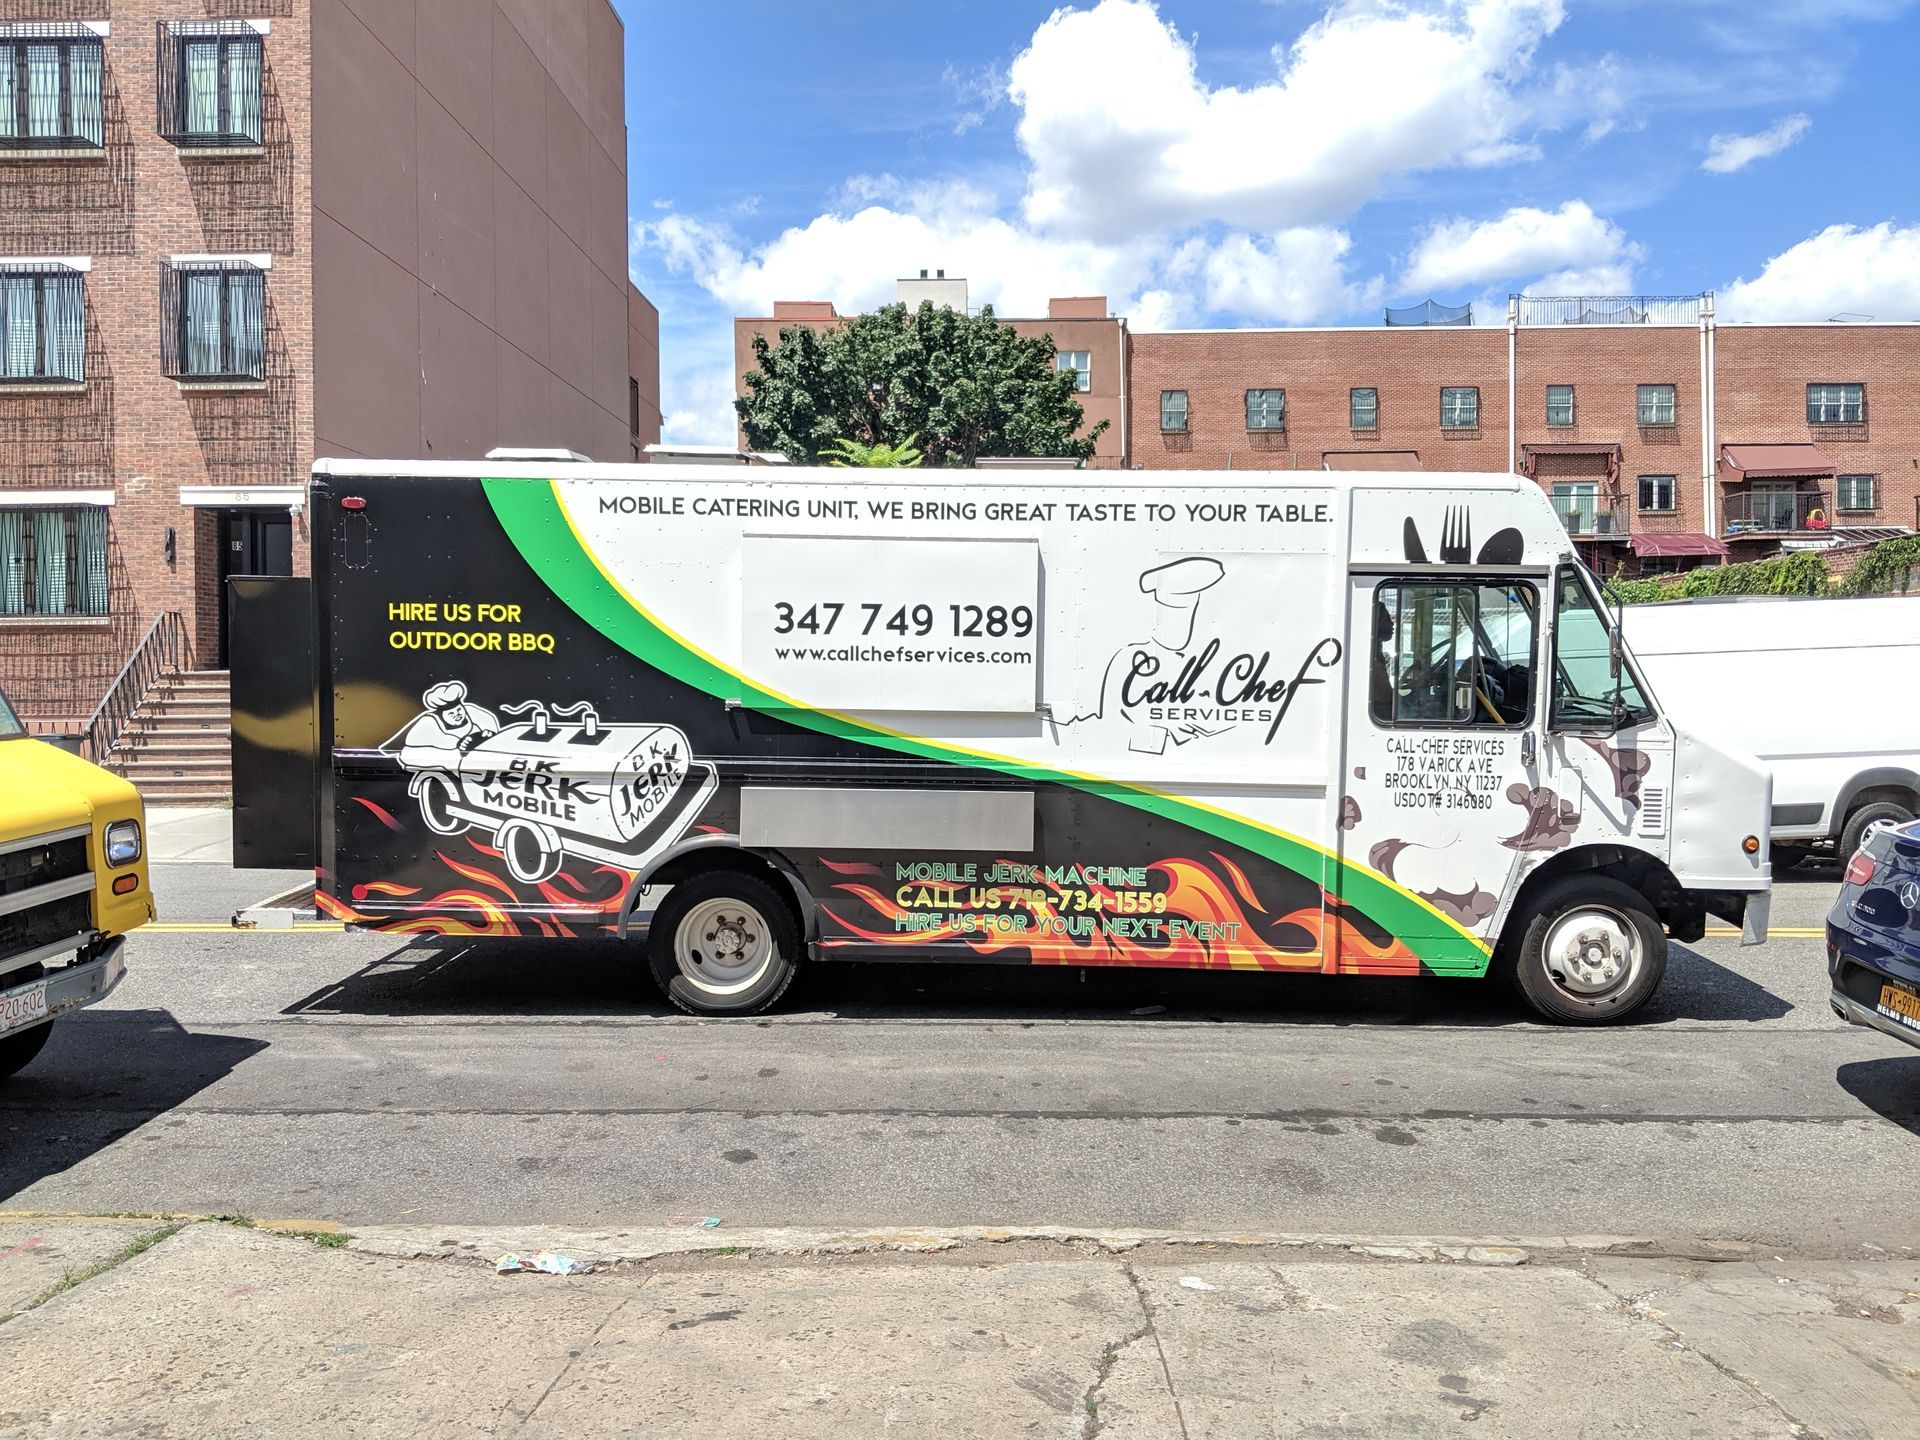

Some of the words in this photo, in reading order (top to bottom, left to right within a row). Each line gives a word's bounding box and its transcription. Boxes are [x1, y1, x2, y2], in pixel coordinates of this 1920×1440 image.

[599, 496, 685, 515] MOBILE
[693, 498, 800, 517] CATERING
[807, 500, 859, 521] UNIT,
[867, 501, 904, 520] WE
[911, 502, 978, 520] BRING
[985, 502, 1057, 521] GREAT
[1066, 503, 1136, 521] TASTE
[1144, 504, 1176, 522] TO
[1185, 504, 1247, 522] YOUR
[1256, 504, 1333, 523] TABLE.
[232, 541, 244, 551] 85
[388, 603, 437, 621] HIRE
[443, 604, 471, 622] US
[478, 604, 522, 623] FOR
[774, 602, 845, 635] 347
[860, 603, 934, 637] 749
[949, 604, 1033, 637] 1289
[389, 631, 502, 651] OUTDOOR
[508, 633, 556, 654] BBQ
[775, 645, 1032, 664] www.callchefservices.com
[1150, 708, 1272, 722] SERVICES
[1386, 738, 1450, 754] CALL-CHEF
[1453, 740, 1505, 755] SERVICES
[1397, 756, 1415, 771] 178
[1419, 756, 1463, 772] VARICK
[1467, 758, 1493, 773] AVE
[473, 769, 601, 805] JERK
[619, 743, 682, 816] JERK
[1385, 773, 1452, 791] BROOKLYN,
[1456, 775, 1472, 789] NY
[1475, 776, 1503, 791] 11237
[483, 788, 576, 822] MOBILE
[629, 768, 683, 828] MOBILE
[1394, 792, 1442, 809] USDOT#
[895, 862, 977, 882] MOBILE
[983, 864, 1038, 884] JERK
[1045, 865, 1147, 887] MACHINE
[895, 886, 962, 908] CALL
[970, 888, 1001, 909] US
[1008, 888, 1167, 914] 718-734-1559
[895, 912, 942, 932] HIRE
[949, 914, 976, 933] US
[982, 914, 1028, 935] FOR
[1035, 916, 1096, 936] YOUR
[1102, 917, 1163, 938] NEXT
[1169, 920, 1241, 941] EVENT
